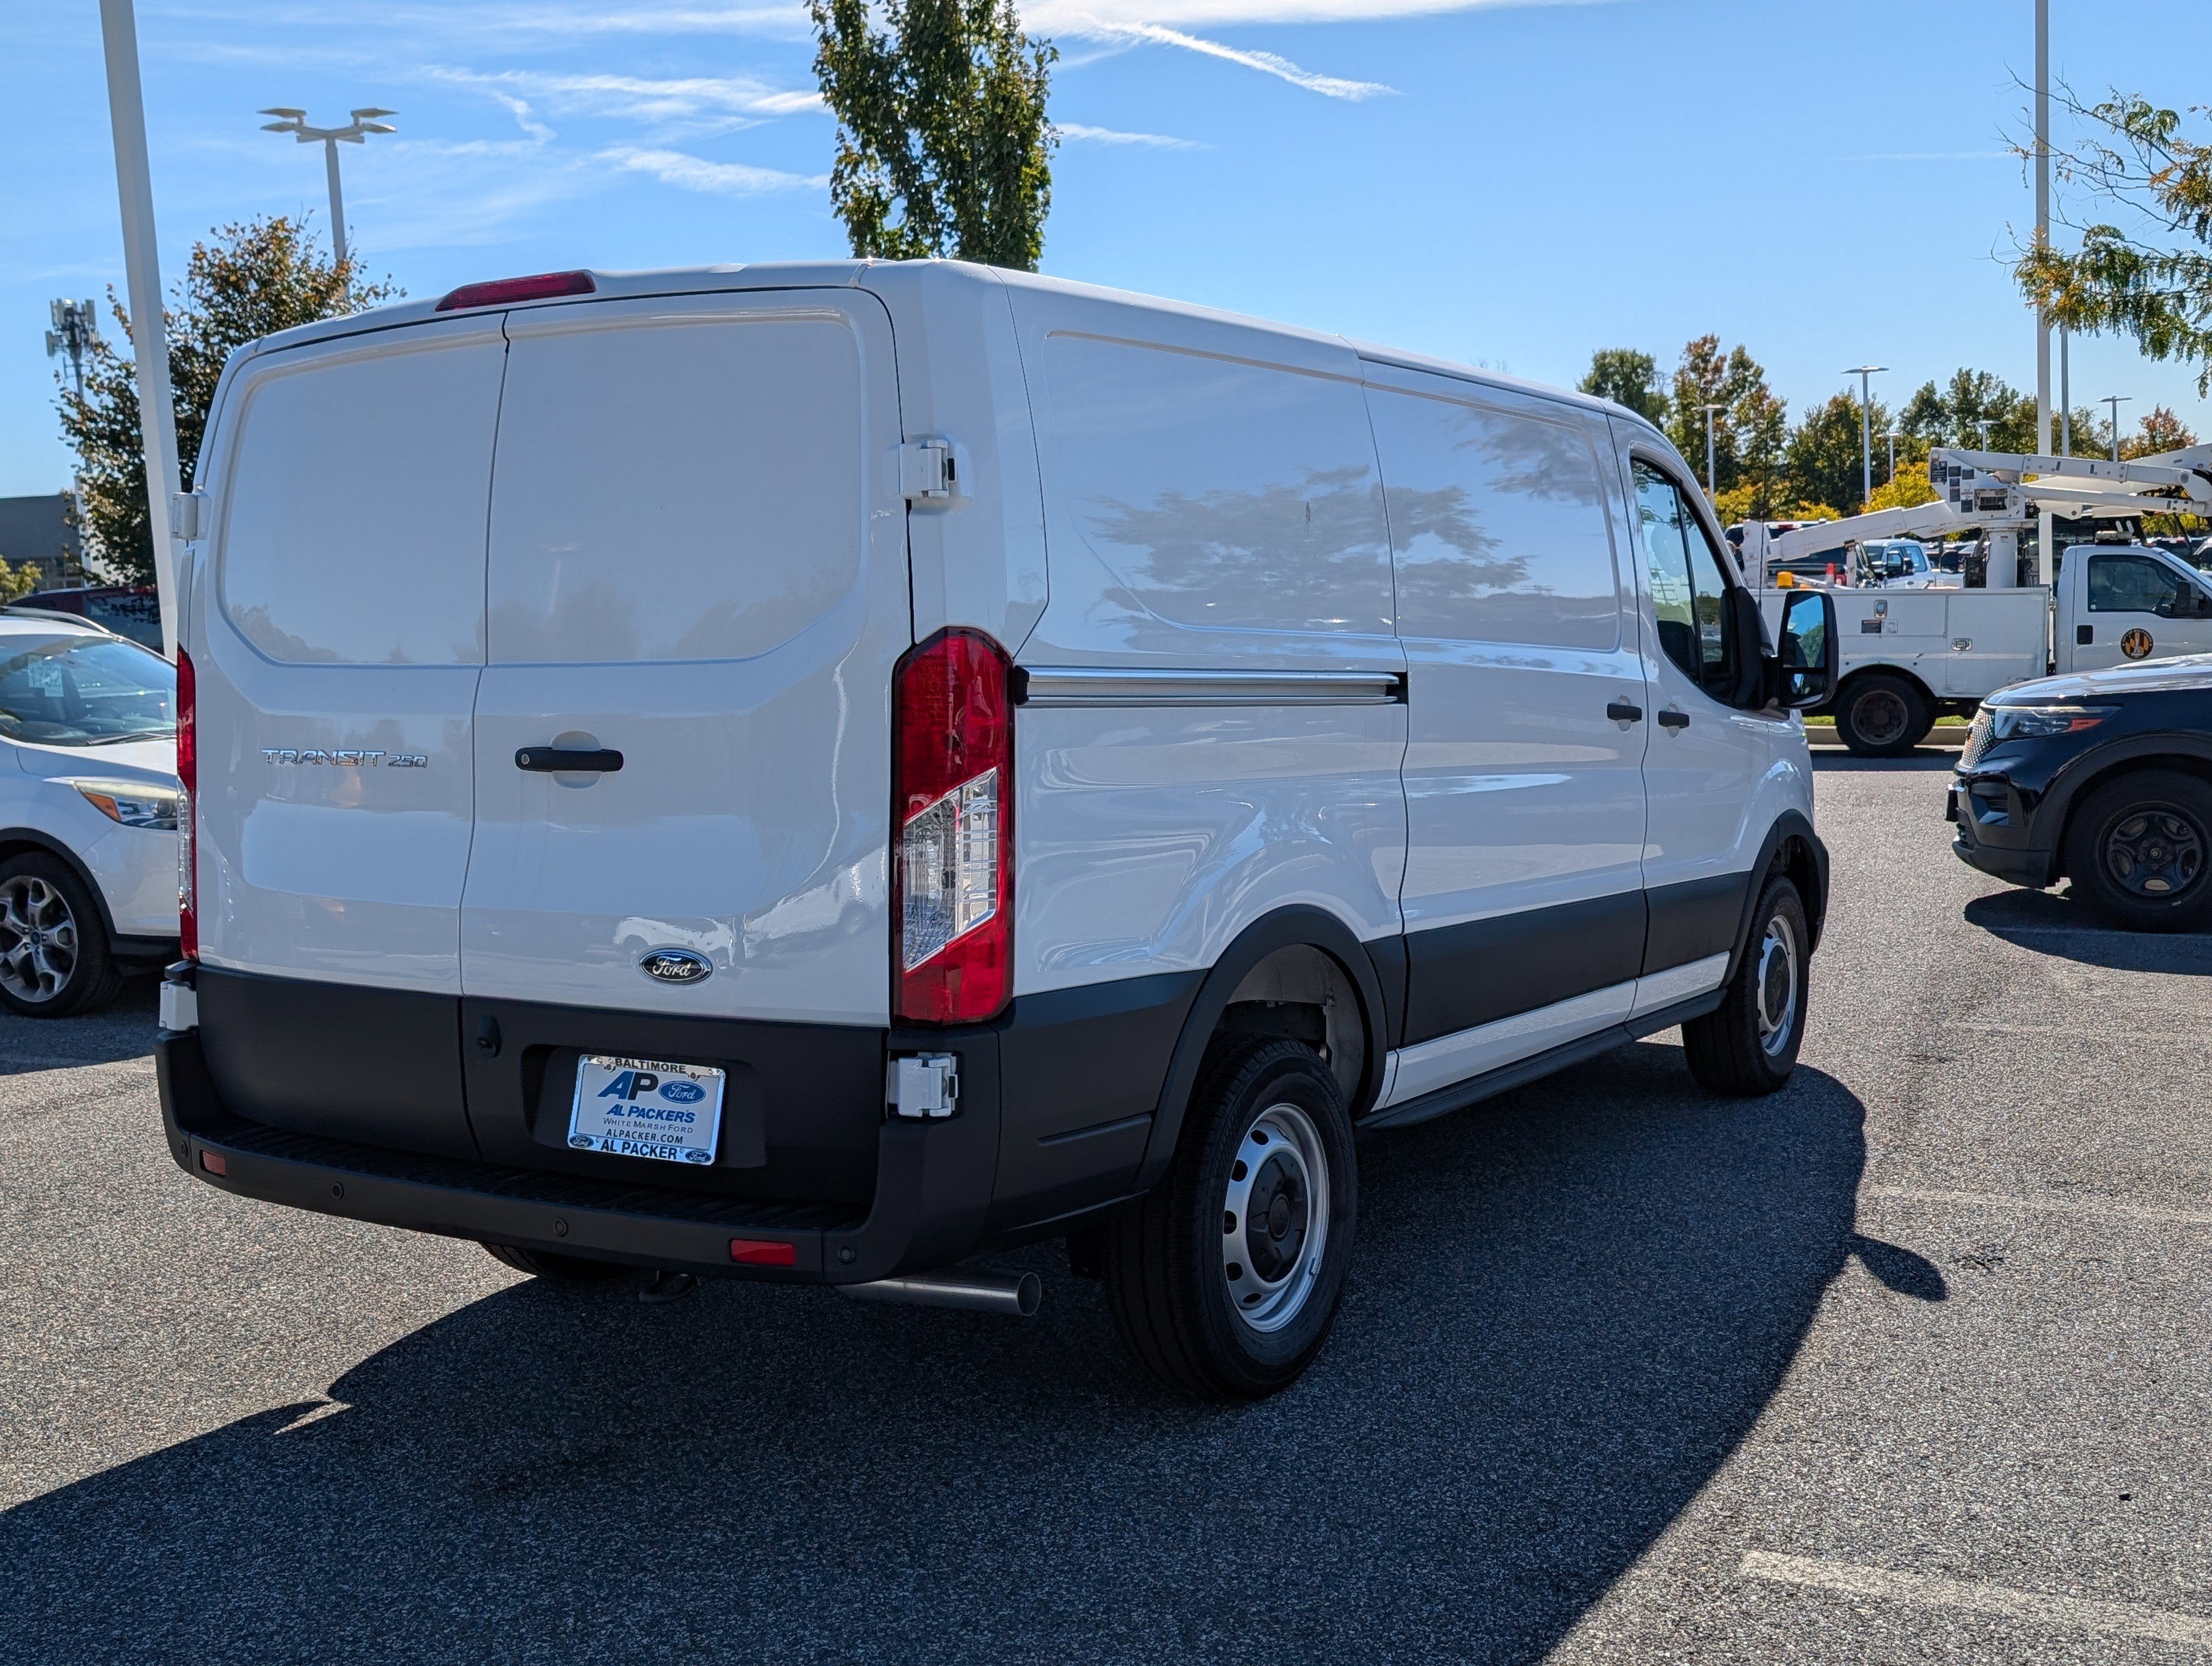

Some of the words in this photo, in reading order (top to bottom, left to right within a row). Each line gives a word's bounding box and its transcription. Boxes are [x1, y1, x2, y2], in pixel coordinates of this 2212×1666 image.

[261, 748, 386, 766] TRANSIT
[388, 754, 428, 768] 250
[652, 956, 692, 976] Ford
[615, 1058, 686, 1074] BALTIMORE
[596, 1071, 659, 1101] AP
[606, 1104, 625, 1117] AL
[627, 1106, 696, 1124] PACKER'S
[606, 1129, 683, 1144] ALPACKER.COM
[600, 1139, 618, 1152] AL
[621, 1143, 677, 1160] PACKER
